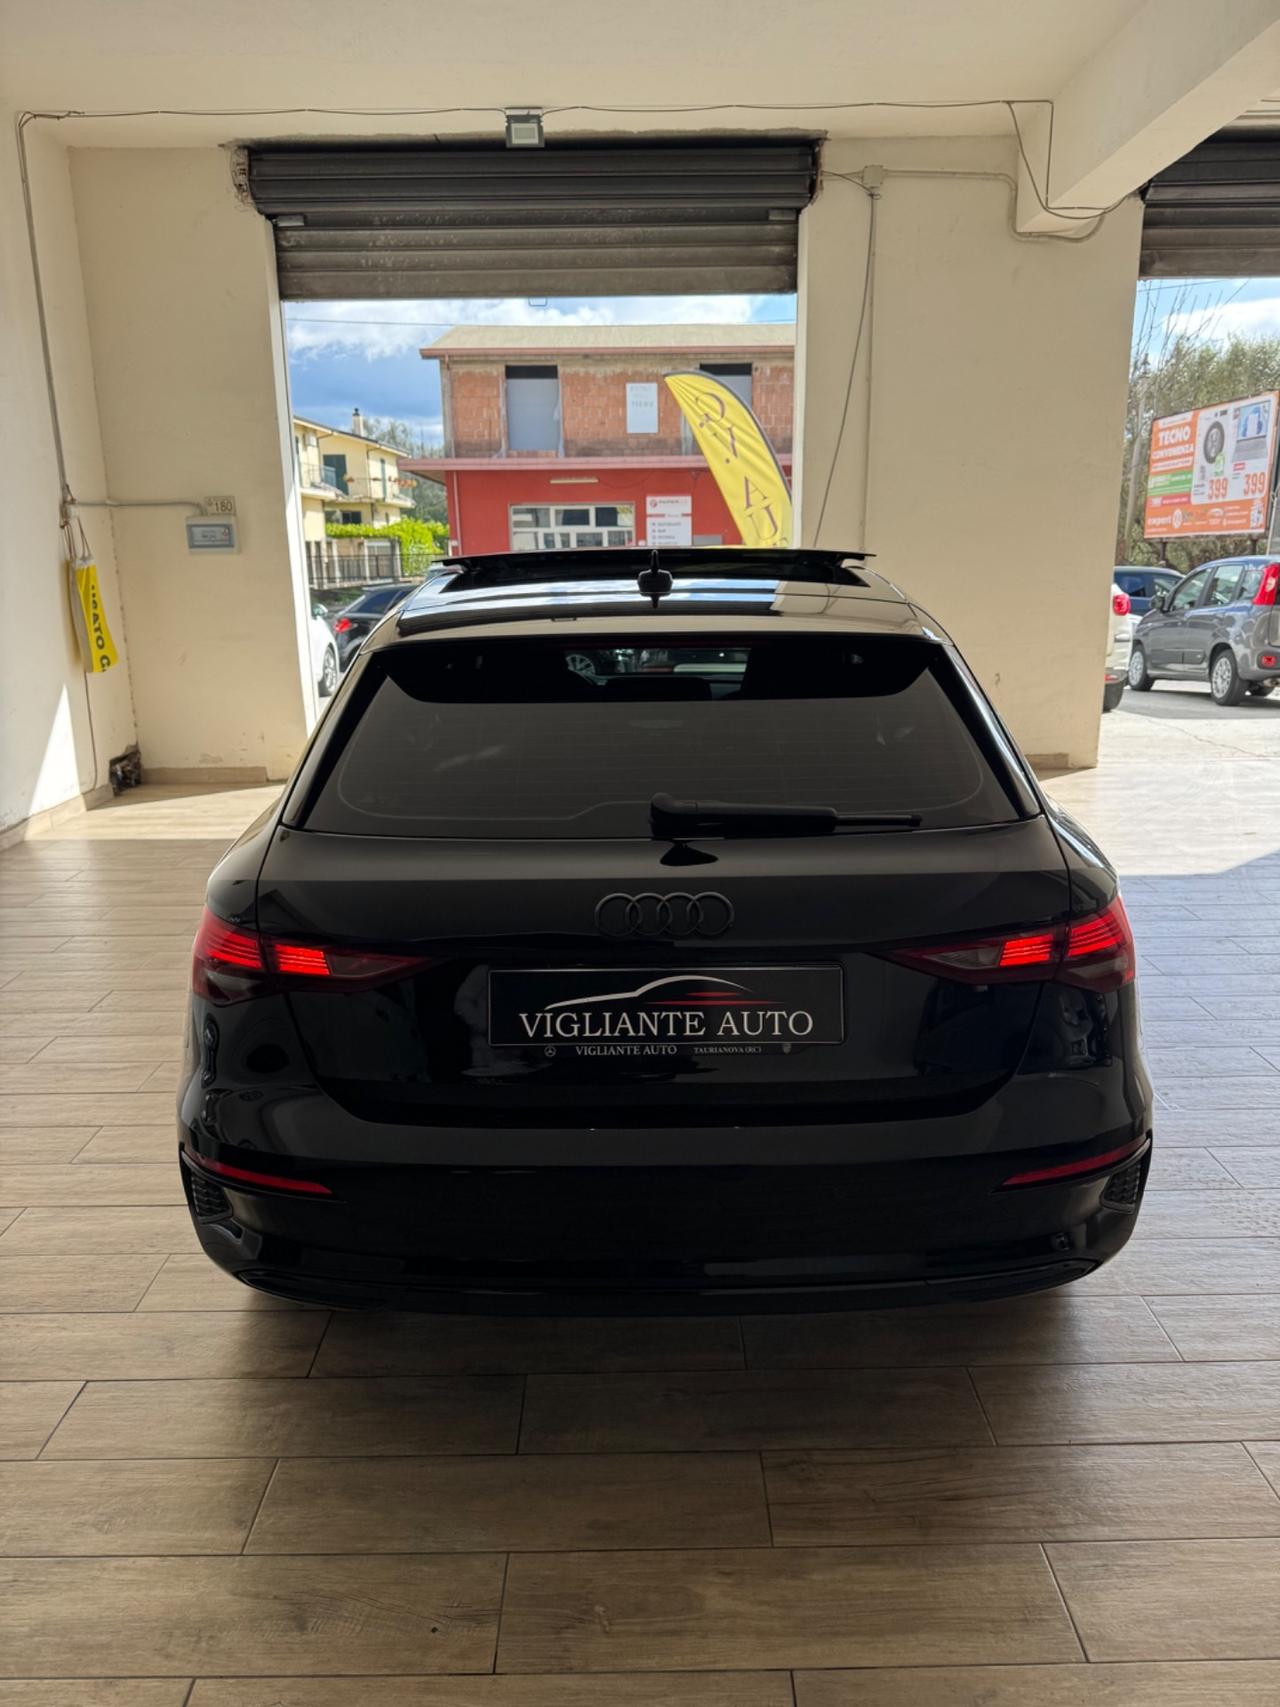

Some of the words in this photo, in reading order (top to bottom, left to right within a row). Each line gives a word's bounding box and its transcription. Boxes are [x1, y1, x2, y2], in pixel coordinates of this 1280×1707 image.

[1158, 425, 1192, 447] TECNO
[1206, 477, 1229, 500] 399
[1242, 471, 1267, 497] 399
[214, 500, 233, 512] 180
[519, 1011, 706, 1038] VIGLIANTE
[717, 1010, 814, 1037] AUTO
[575, 1046, 640, 1056] VIGLIANTE
[643, 1045, 678, 1055] AUTO
[693, 1046, 744, 1054] TAURIANOVA
